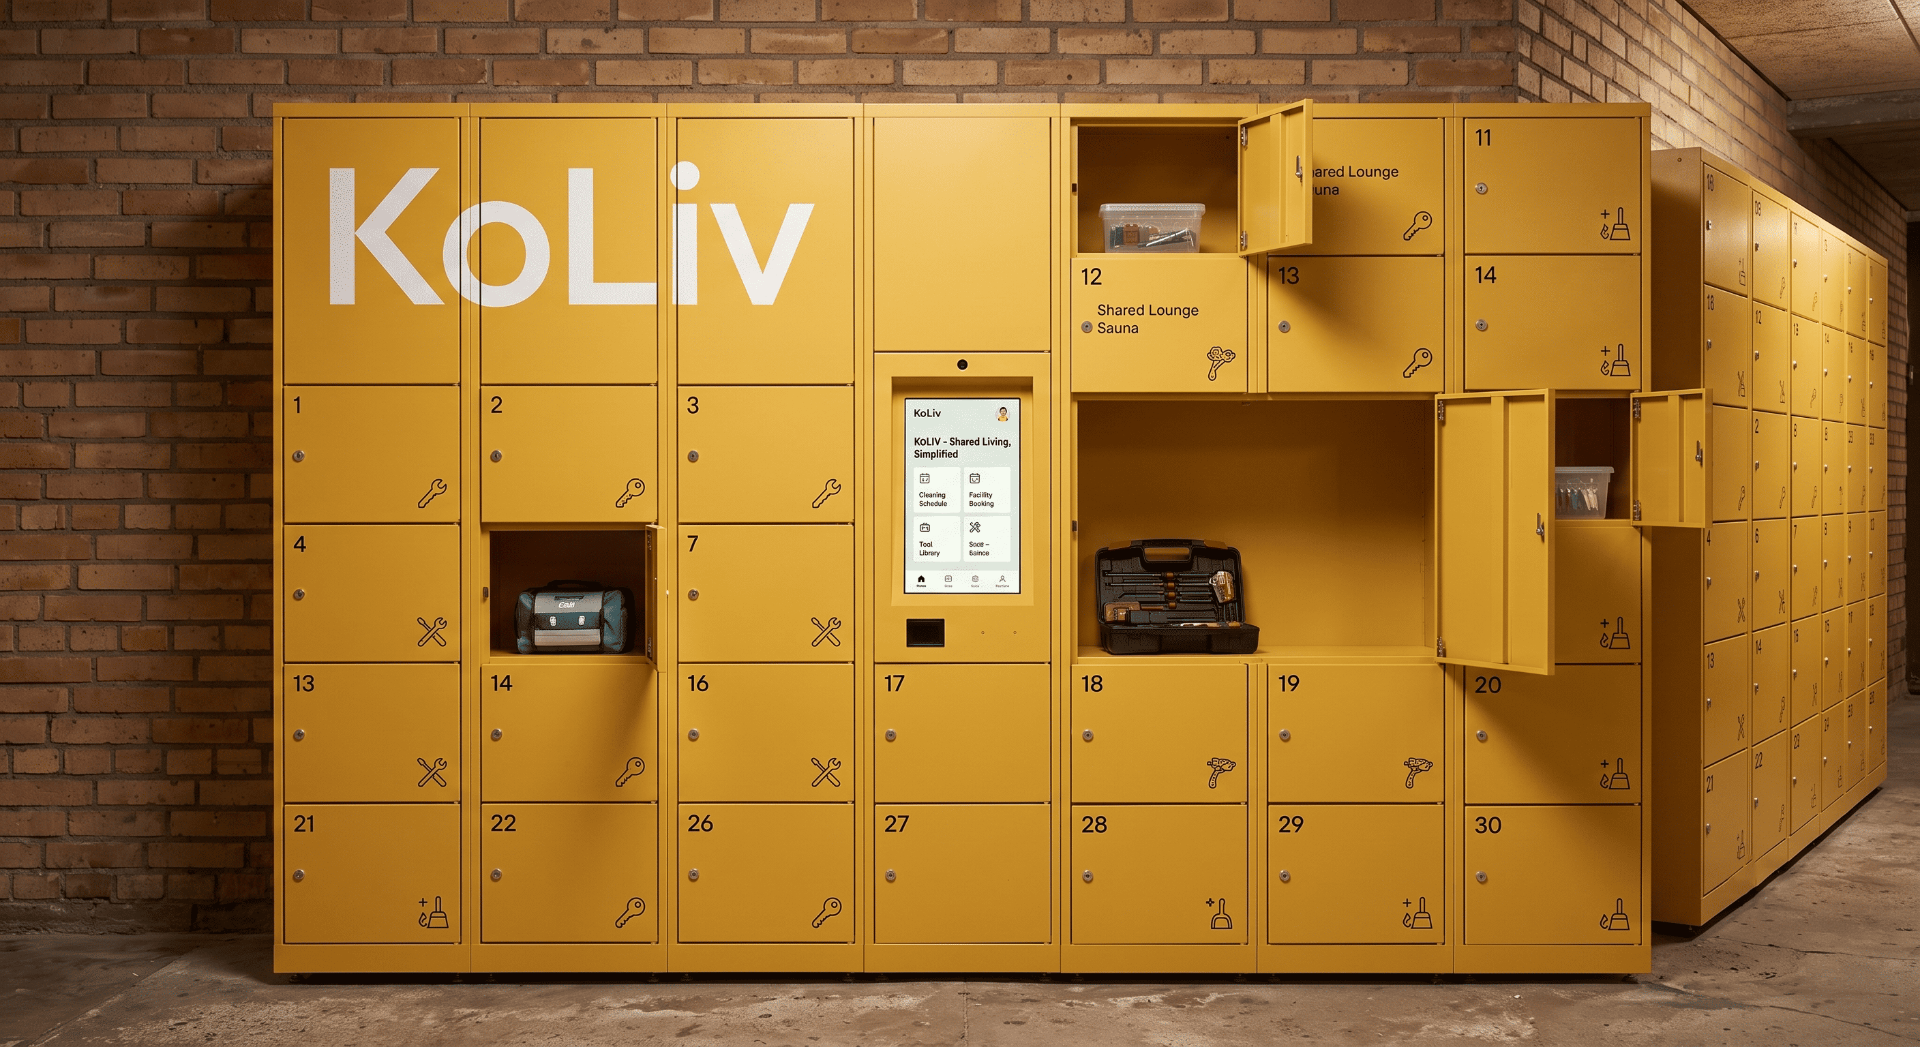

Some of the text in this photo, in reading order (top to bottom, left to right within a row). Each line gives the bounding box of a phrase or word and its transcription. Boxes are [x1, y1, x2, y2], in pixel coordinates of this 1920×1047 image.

[1475, 129, 1492, 146] 11
[1348, 165, 1399, 181] Lounge
[1313, 185, 1340, 196] una
[329, 160, 816, 308] KoLiv
[1081, 267, 1103, 286] 12
[1278, 267, 1300, 285] 13
[1475, 266, 1497, 284] 14
[1097, 303, 1200, 322] Shared Lounge
[1097, 321, 1140, 334] Sauna
[293, 396, 302, 414] 1
[490, 396, 503, 414] 2
[687, 396, 699, 415] 3
[913, 408, 942, 418] KoLiv
[949, 437, 980, 446] Shared
[982, 437, 1012, 449] Living,
[913, 450, 959, 461] Simplified
[919, 491, 946, 499] Cleaning
[968, 500, 995, 508] Booking
[293, 535, 308, 553] 4
[687, 535, 700, 553] 7
[919, 550, 941, 558] Library
[1706, 652, 1714, 669] 13
[293, 674, 315, 693] 13
[490, 674, 513, 692] 14
[687, 674, 710, 692] 16
[884, 674, 906, 692] 17
[1081, 674, 1103, 693] 18
[1278, 674, 1300, 693] 19
[1475, 676, 1502, 694] 20
[1754, 751, 1763, 770] 22
[1706, 774, 1714, 793] 21
[293, 814, 315, 833] 21
[490, 814, 517, 832] 22
[687, 814, 714, 833] 26
[884, 814, 910, 833] 27
[1081, 815, 1108, 834] 28
[1278, 815, 1305, 833] 29
[1474, 816, 1502, 834] 30
